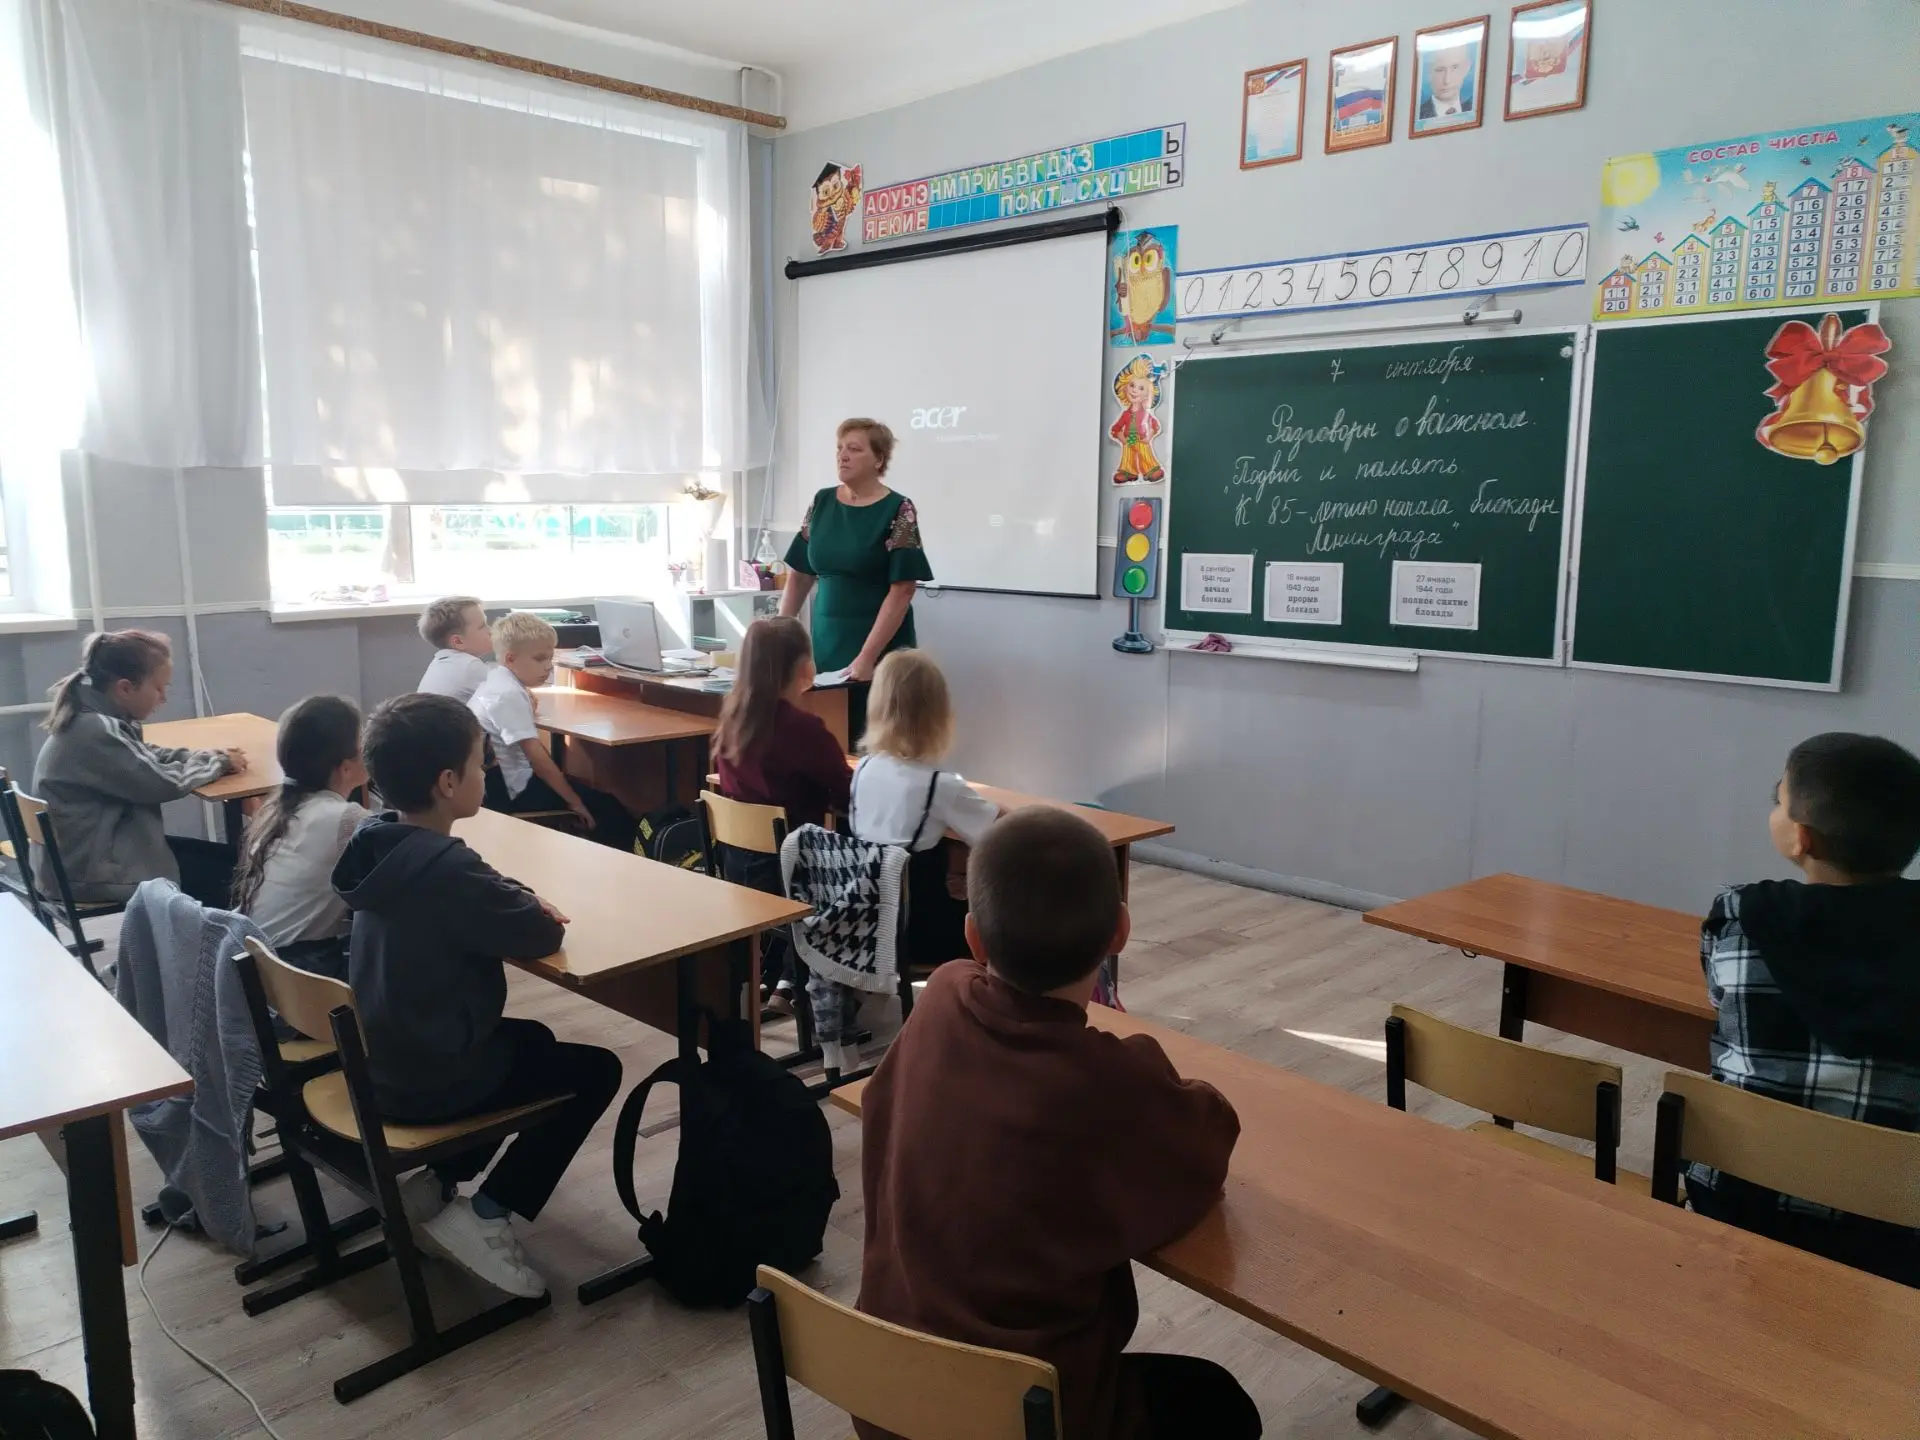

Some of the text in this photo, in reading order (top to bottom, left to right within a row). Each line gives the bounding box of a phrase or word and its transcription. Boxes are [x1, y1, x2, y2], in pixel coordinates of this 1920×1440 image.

[1688, 130, 1839, 163] СОСТАВ ЧИСЛА
[1331, 358, 1345, 383] 7
[910, 406, 967, 429] acer
[1267, 404, 1379, 461] Разговоры
[1395, 417, 1409, 437] о
[1320, 465, 1336, 481] и
[1384, 499, 1455, 517] начала
[1470, 479, 1561, 532] блокады
[1416, 575, 1425, 583] 27
[1415, 607, 1454, 617] блокады
